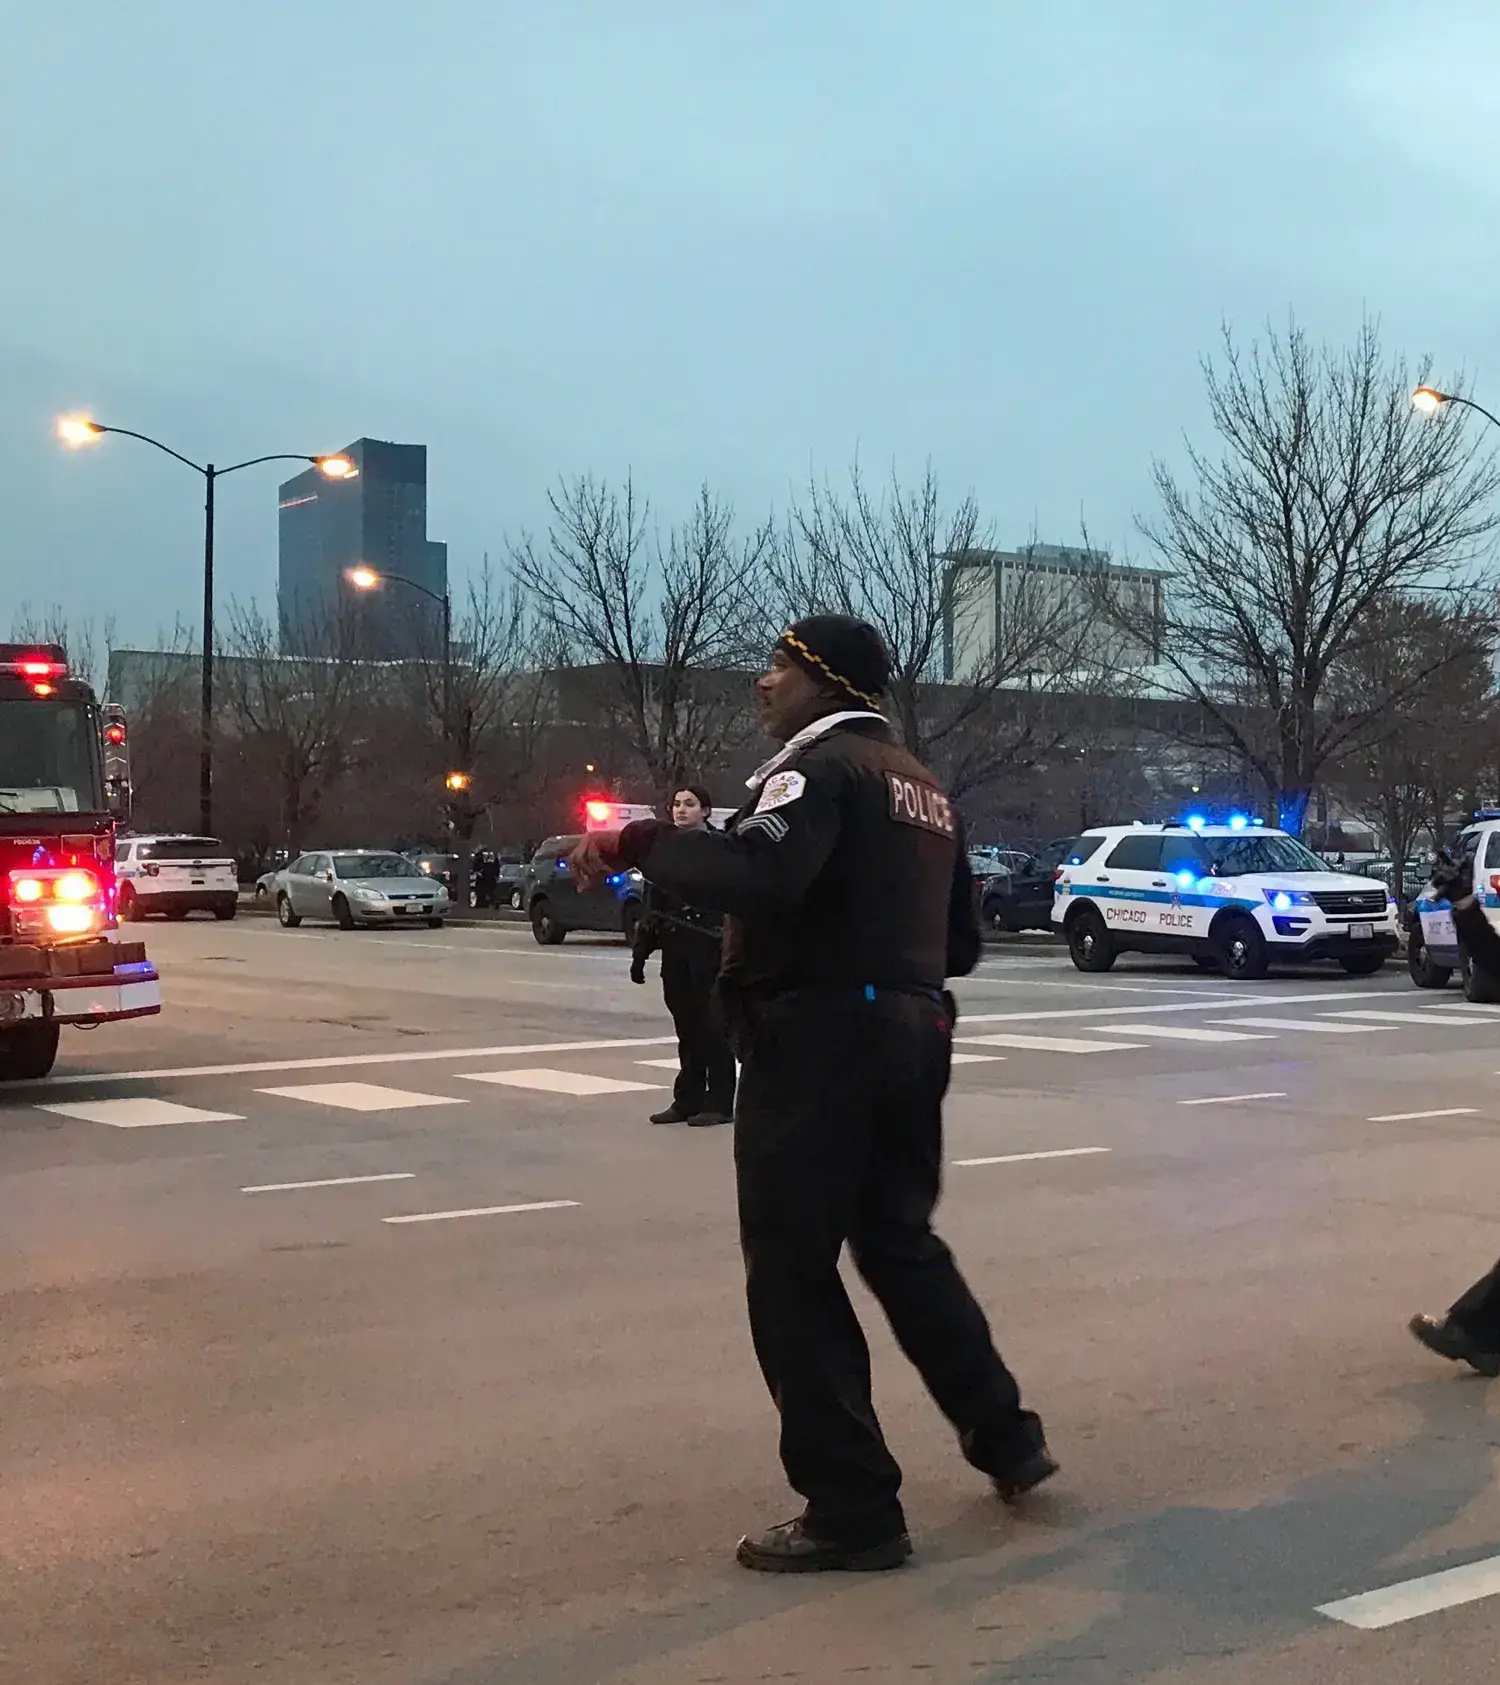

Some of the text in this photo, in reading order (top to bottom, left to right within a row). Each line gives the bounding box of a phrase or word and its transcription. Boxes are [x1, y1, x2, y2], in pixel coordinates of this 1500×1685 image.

[891, 777, 953, 831] POLICE
[1106, 907, 1193, 927] CHICAGO POLICE
